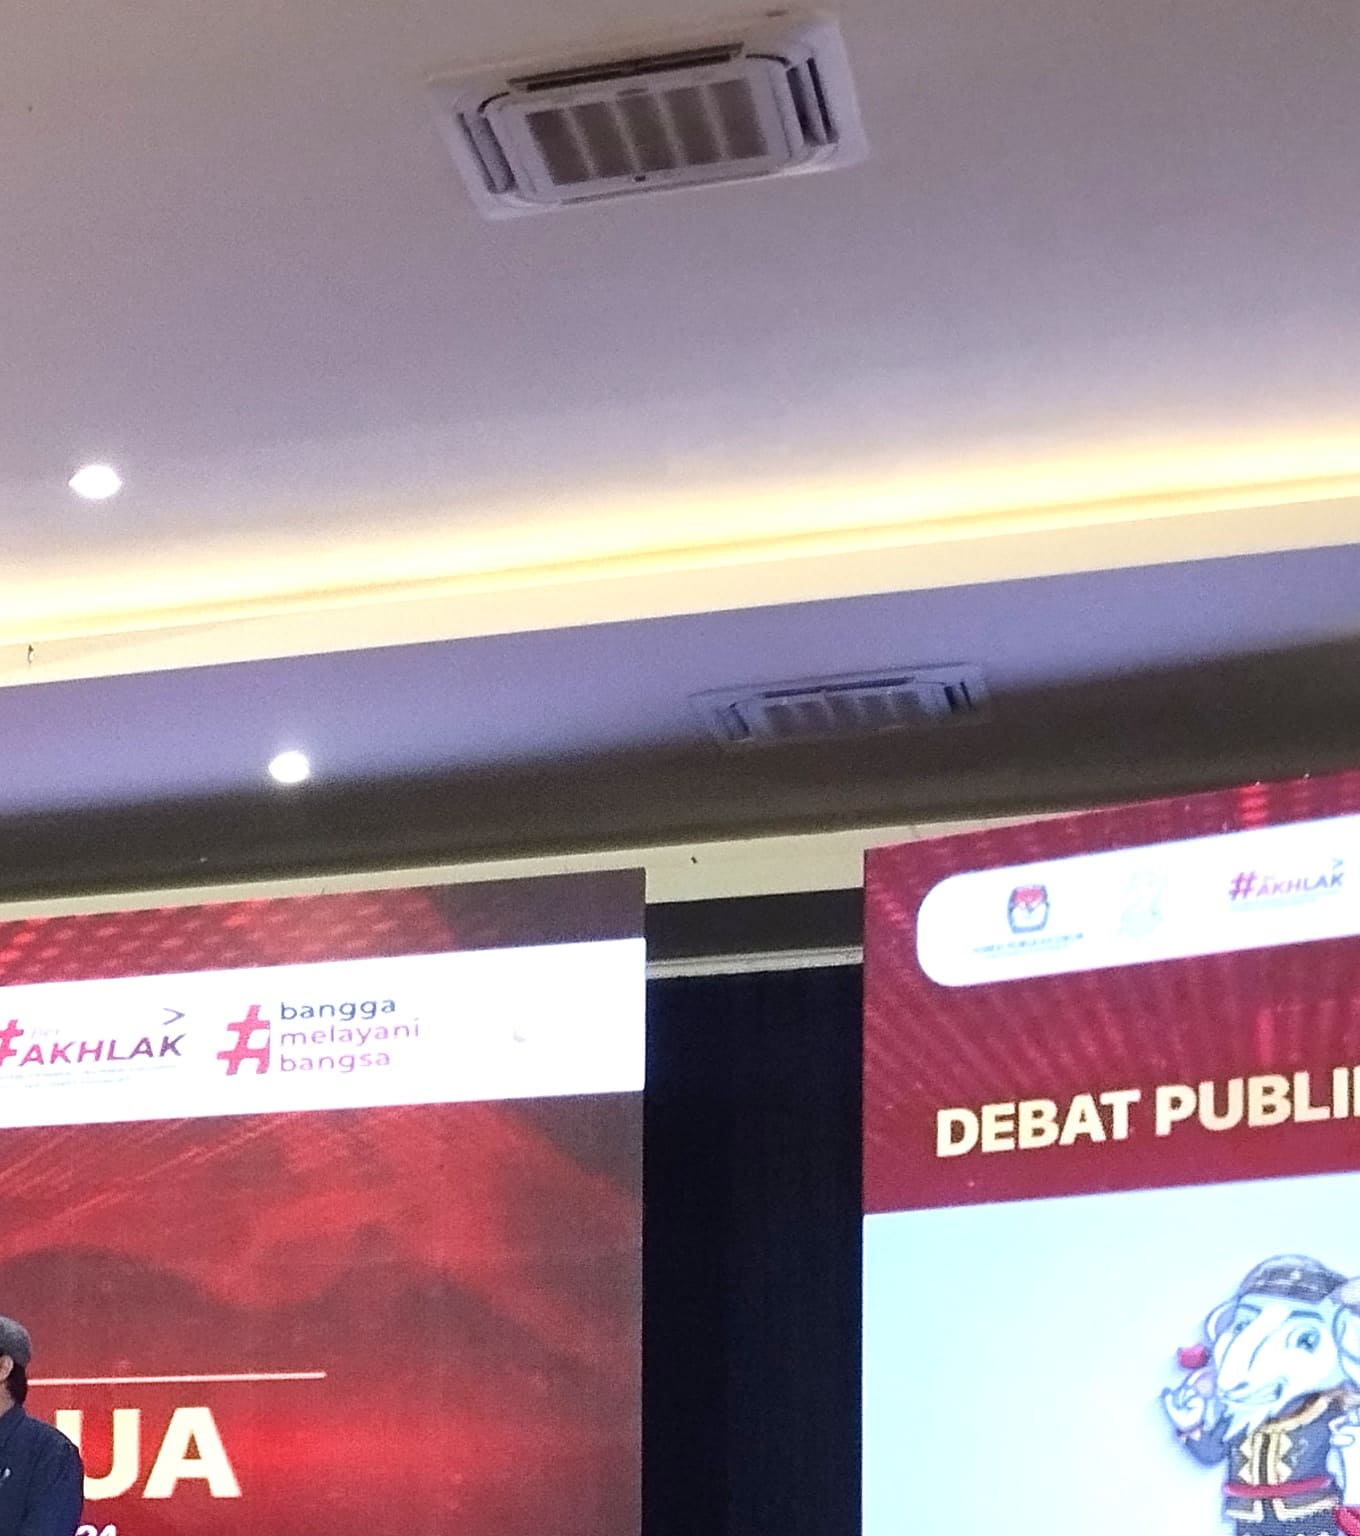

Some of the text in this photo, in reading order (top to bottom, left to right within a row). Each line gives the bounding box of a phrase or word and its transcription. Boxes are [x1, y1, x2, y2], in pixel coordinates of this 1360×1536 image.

[280, 999, 396, 1022] bangga
[280, 1017, 421, 1046] melayani
[280, 1050, 391, 1074] bangsa
[936, 1088, 1141, 1158] DEBAT
